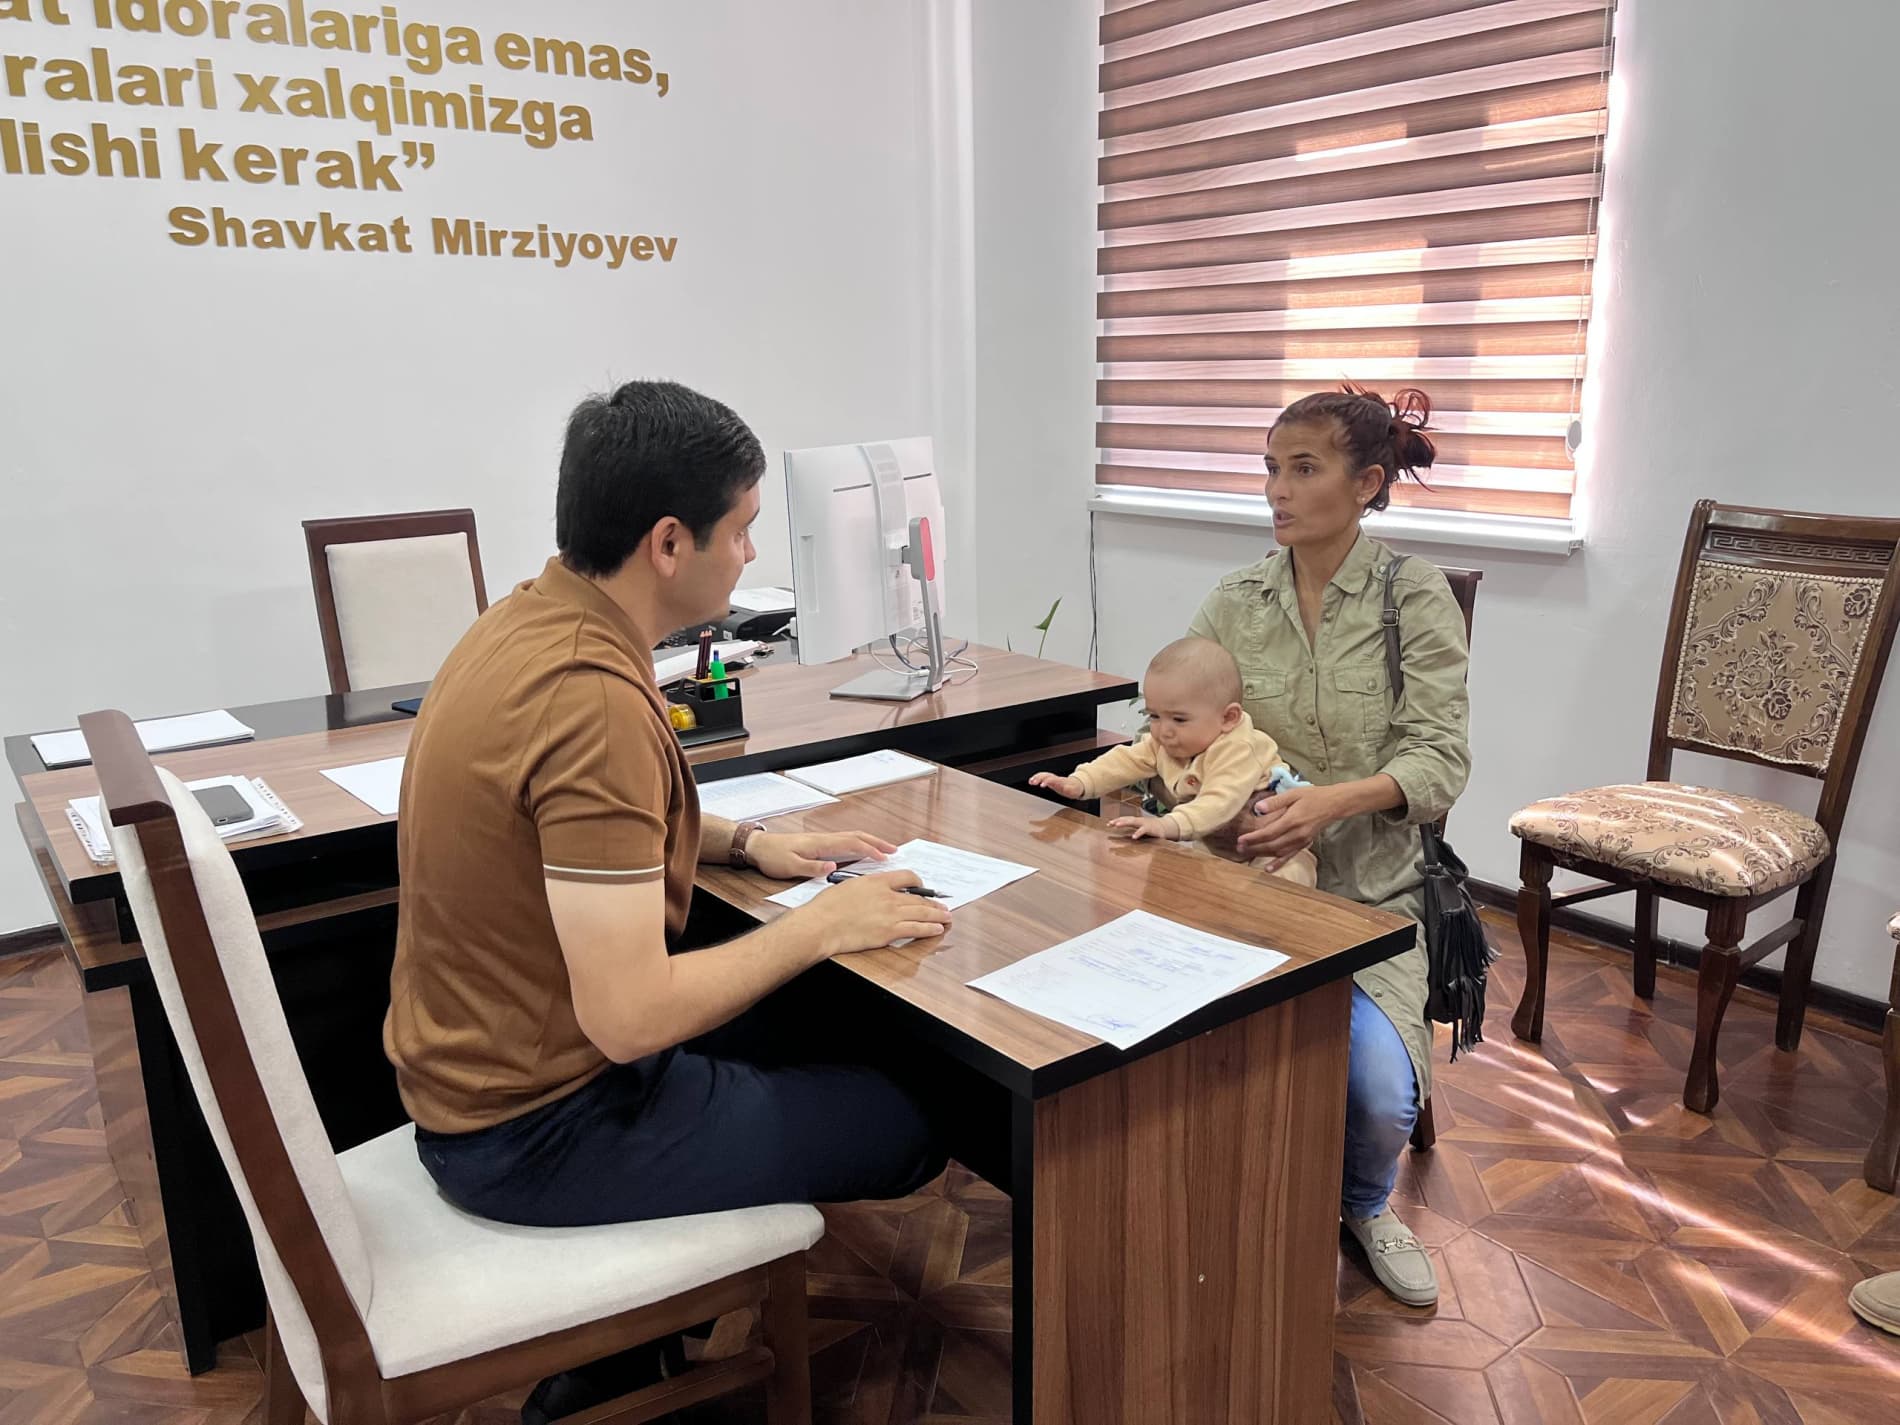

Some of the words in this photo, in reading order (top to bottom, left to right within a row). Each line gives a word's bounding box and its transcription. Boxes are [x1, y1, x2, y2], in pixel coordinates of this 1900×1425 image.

[495, 32, 669, 96] emas,
[4, 47, 216, 107] ralari
[238, 67, 593, 148] xalqimizga
[0, 118, 160, 178] lishi
[168, 206, 412, 253] Shavkat
[432, 217, 677, 269] Mirziyoyev
